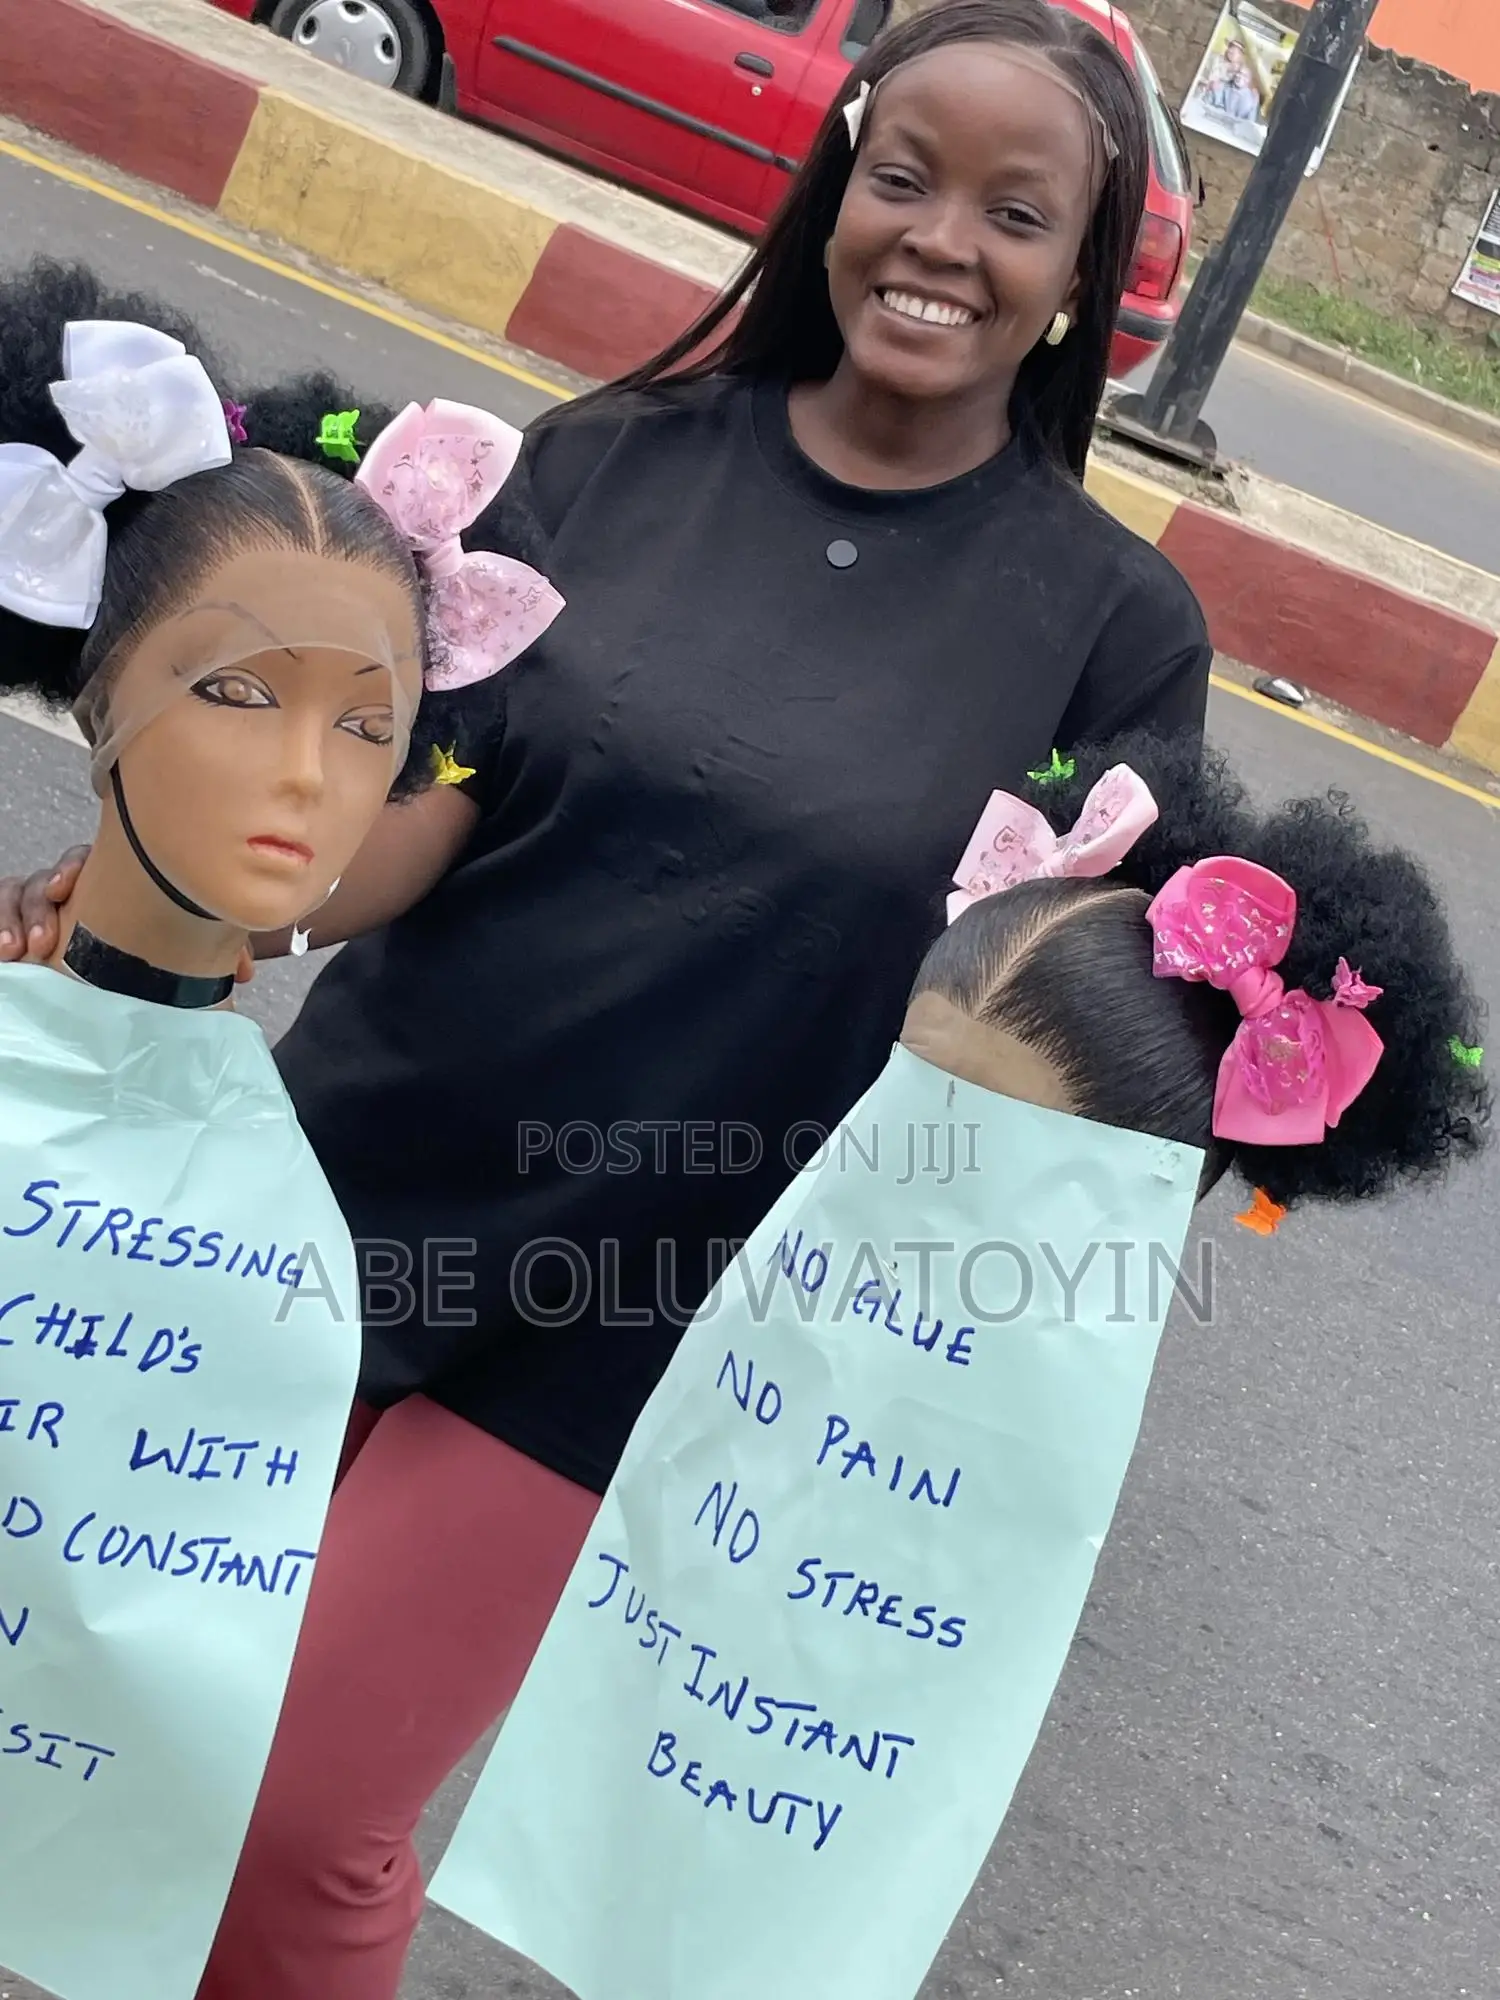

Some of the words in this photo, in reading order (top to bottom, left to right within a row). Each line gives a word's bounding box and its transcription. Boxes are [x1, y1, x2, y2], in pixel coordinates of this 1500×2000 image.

[2, 1180, 304, 1289] STRESSING
[767, 1230, 829, 1293] NO
[852, 1279, 976, 1366] GLUE
[128, 1427, 298, 1487] WITH
[716, 1350, 782, 1426] NO
[816, 1414, 961, 1508] PAIN
[62, 1511, 316, 1596] CONSTANT
[694, 1481, 760, 1564] NO
[787, 1557, 967, 1648] STRESS
[588, 1553, 682, 1665] JUST
[683, 1643, 916, 1779] INSTANT
[646, 1730, 843, 1852] BEAUTY
